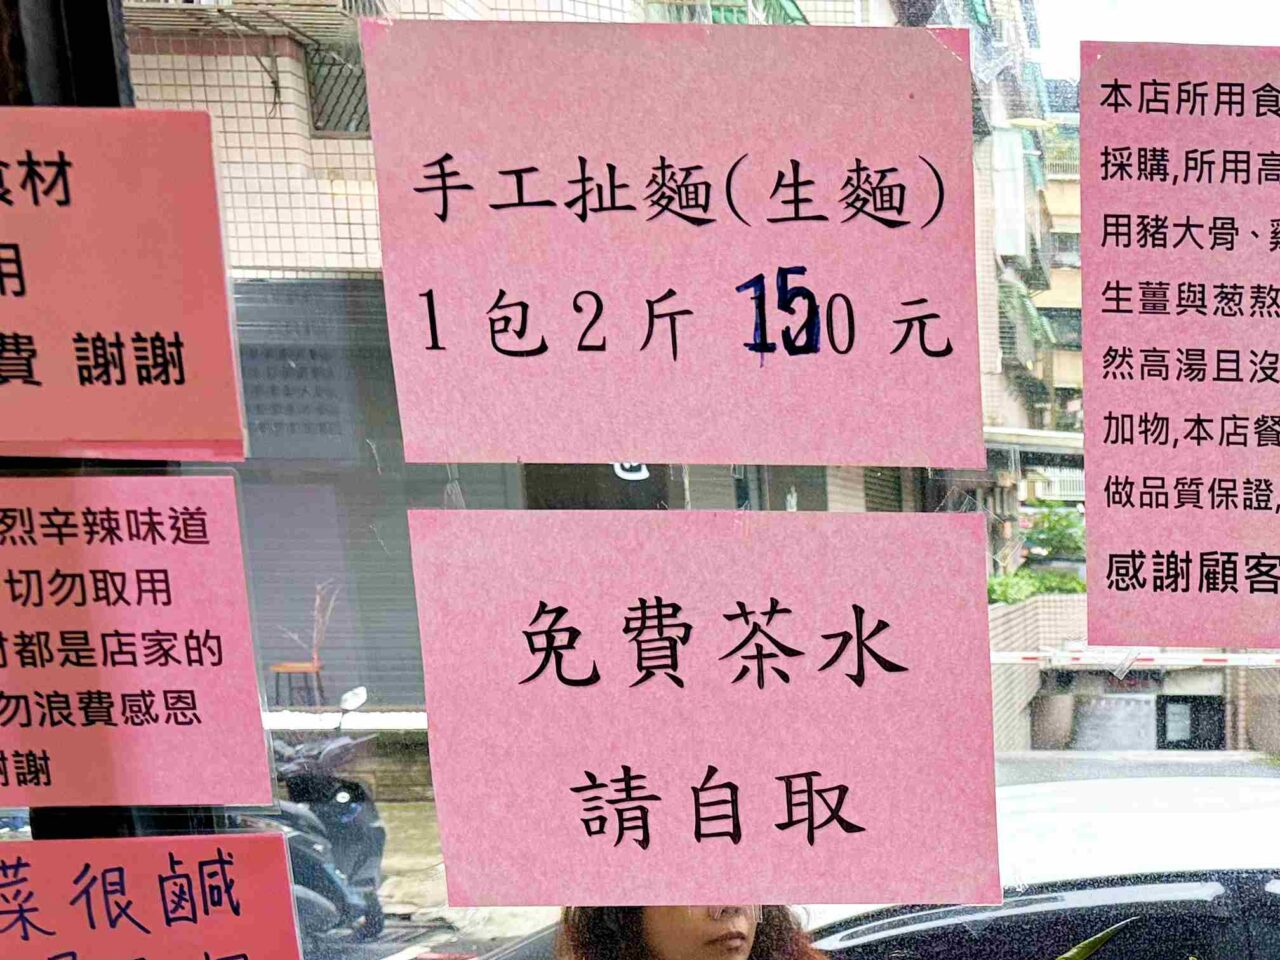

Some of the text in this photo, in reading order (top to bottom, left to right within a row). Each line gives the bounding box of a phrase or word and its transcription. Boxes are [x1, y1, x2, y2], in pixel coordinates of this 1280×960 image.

[413, 152, 945, 229] 手工扯麵(生麵)
[72, 331, 187, 386] 謝謝
[0, 506, 209, 545] 烈辛辣味道
[4, 568, 172, 607] 切勿取用
[0, 629, 223, 668] 都是店家的
[518, 596, 908, 689] 免費茶水
[0, 689, 202, 728] 勿浪費感恩
[570, 764, 866, 849] 請自取
[0, 848, 241, 941] 菜很鹹
